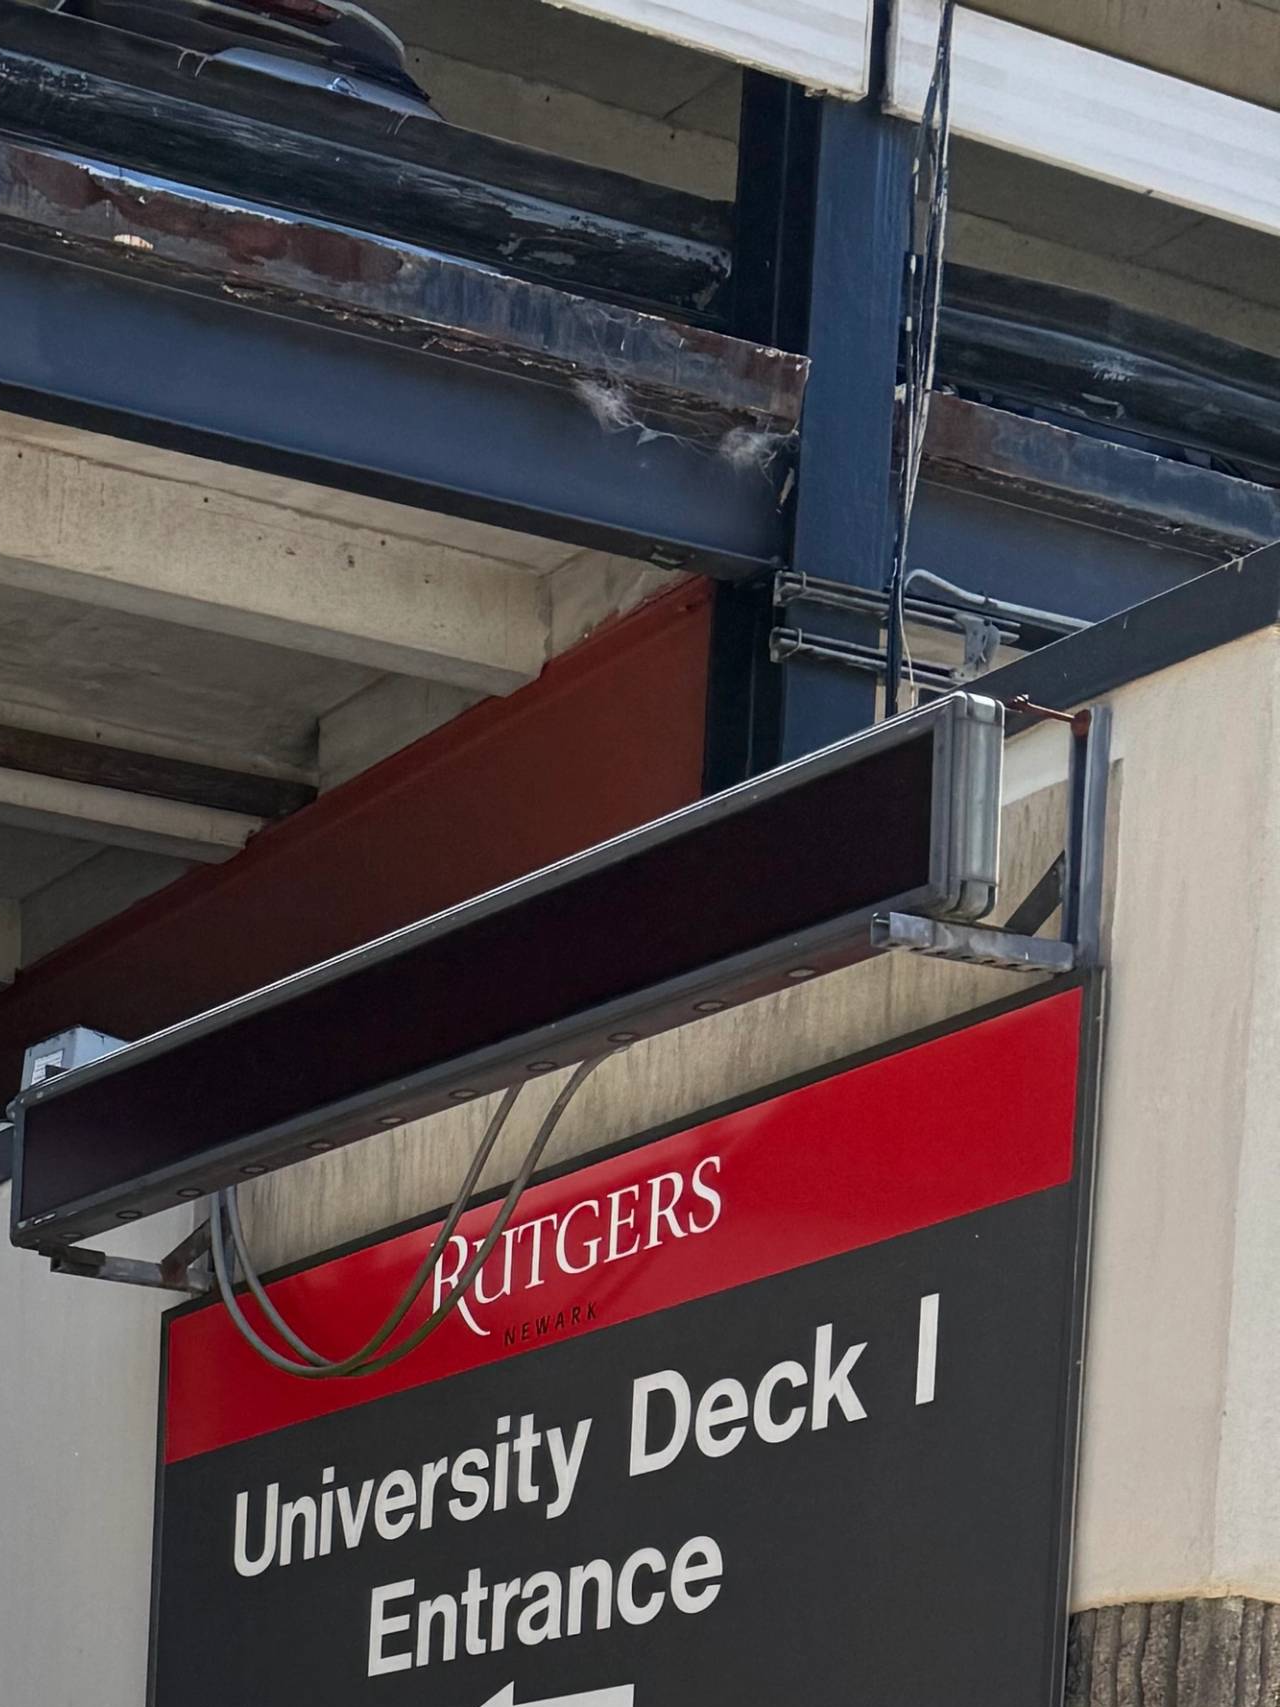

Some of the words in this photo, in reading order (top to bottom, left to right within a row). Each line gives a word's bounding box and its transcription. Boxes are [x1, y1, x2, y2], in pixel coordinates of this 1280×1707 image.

[427, 1155, 722, 1336] RUTGERS
[504, 1302, 598, 1347] NEWARK
[233, 1413, 592, 1577] University
[629, 1323, 868, 1477] Deck
[368, 1535, 723, 1677] Entrance
